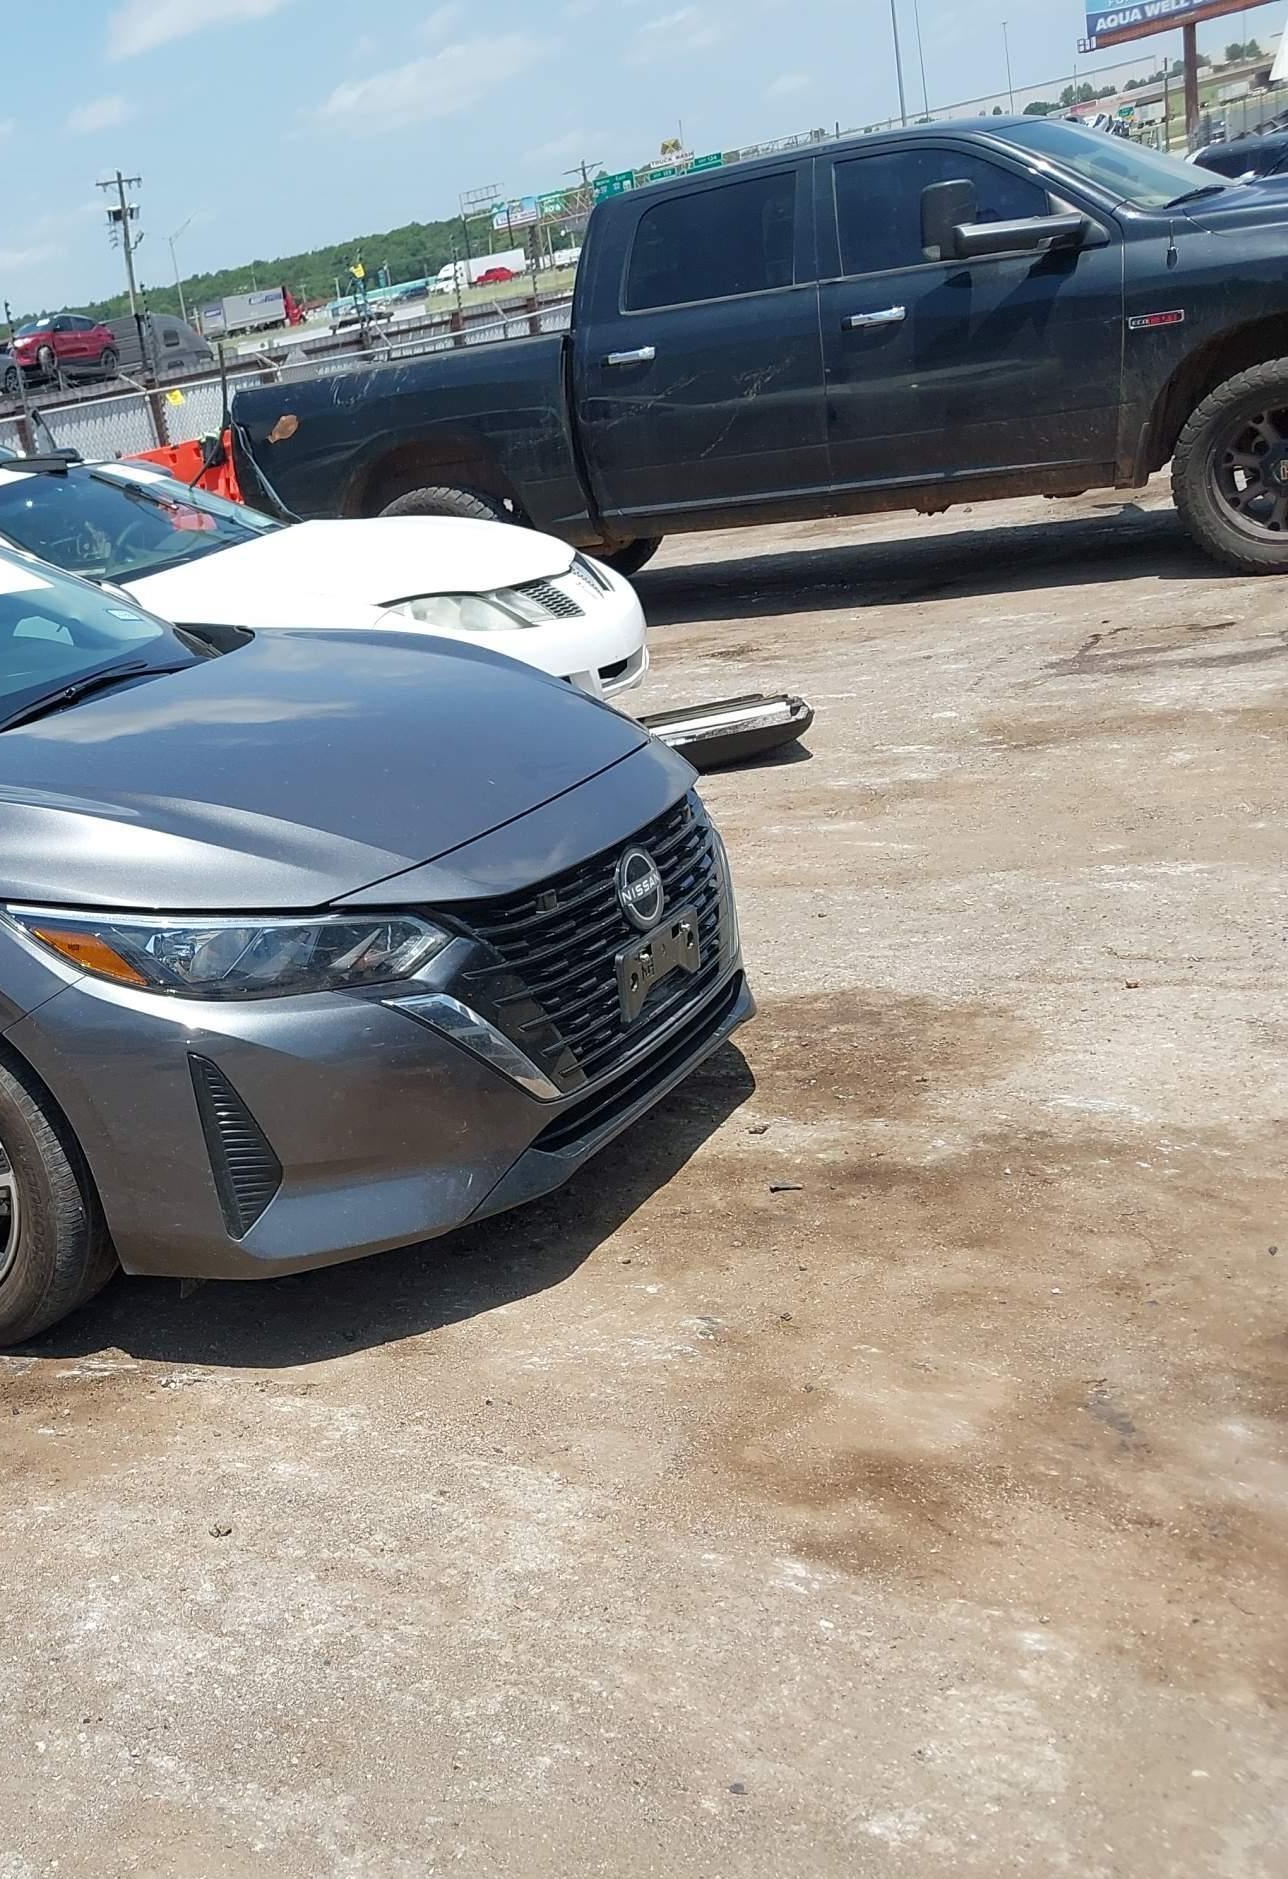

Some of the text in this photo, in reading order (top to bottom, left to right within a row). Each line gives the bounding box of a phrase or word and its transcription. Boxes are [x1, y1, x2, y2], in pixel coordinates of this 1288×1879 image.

[1095, 0, 1190, 32] AQUA WELL
[651, 149, 694, 166] TRUCK WASH
[622, 873, 659, 904] NISSAN
